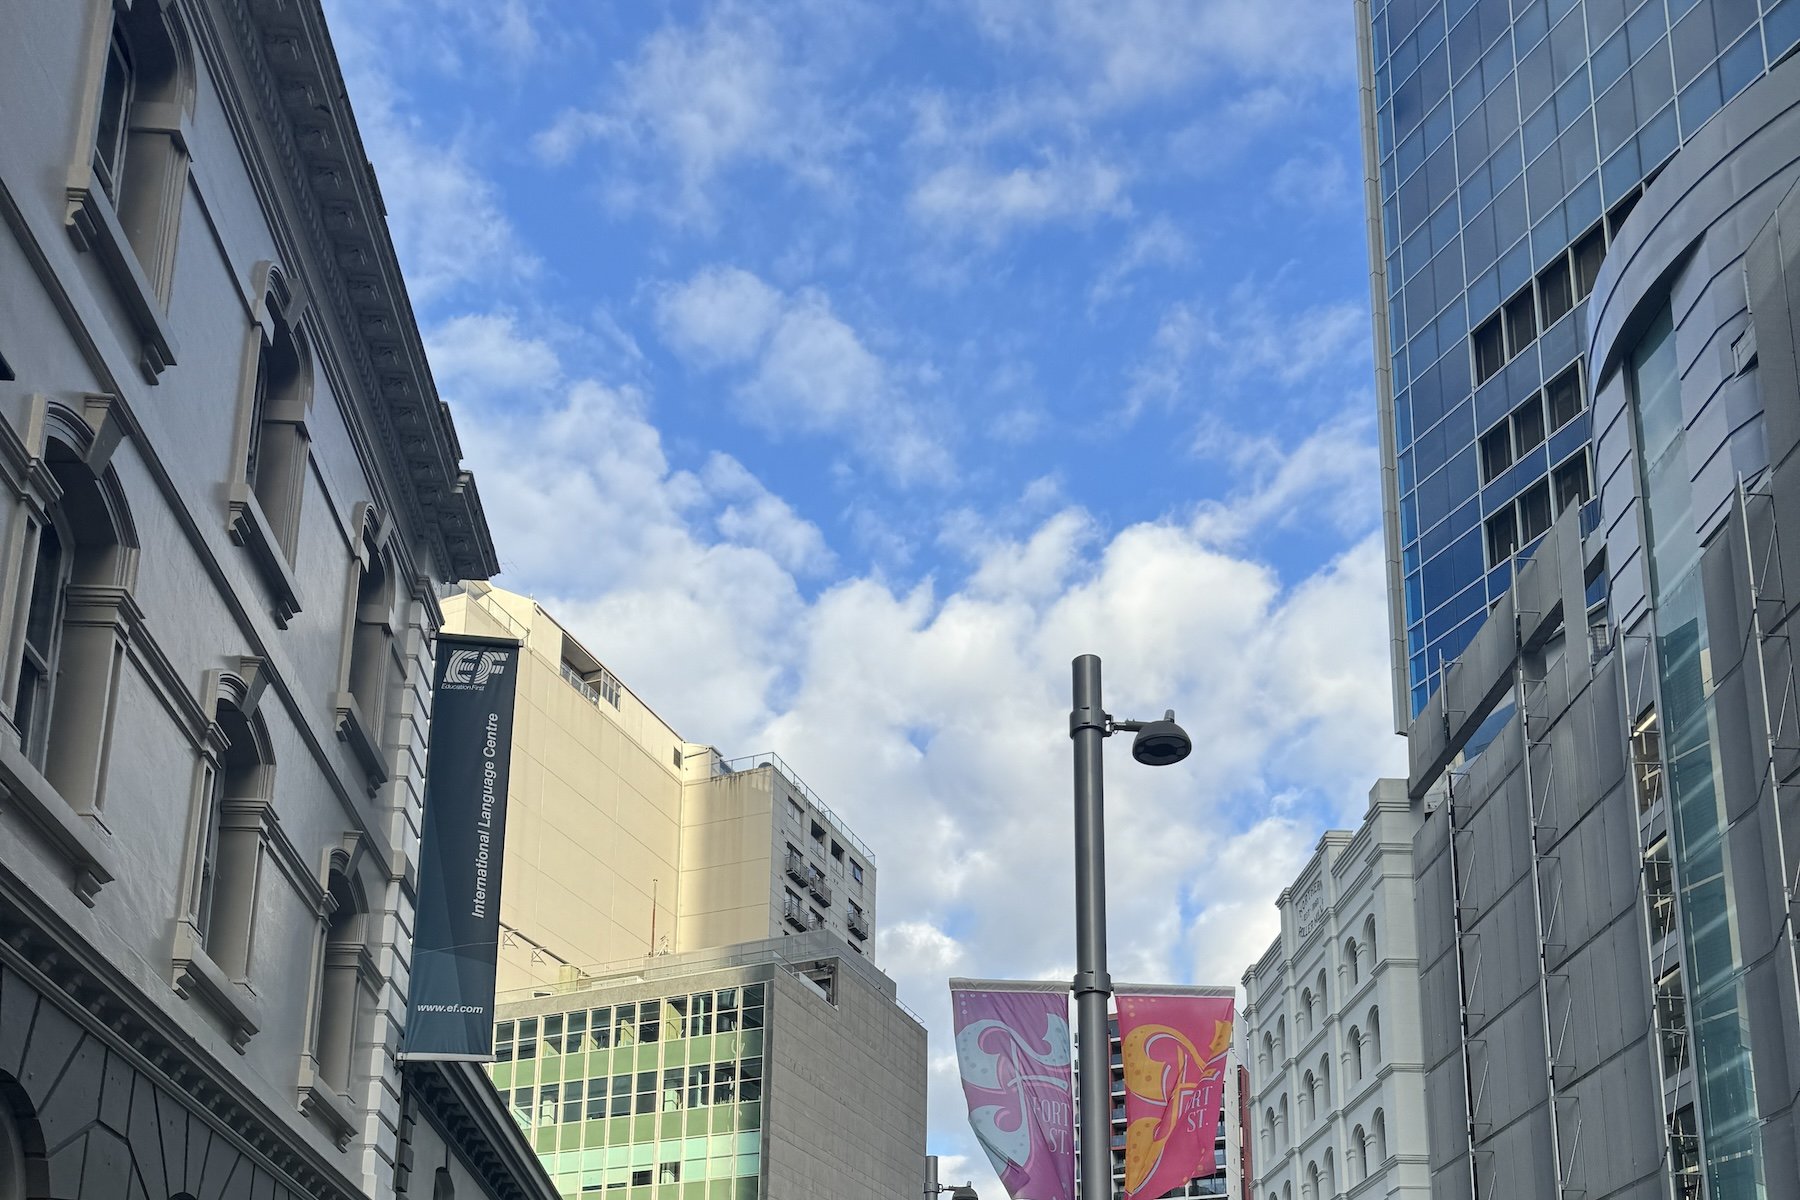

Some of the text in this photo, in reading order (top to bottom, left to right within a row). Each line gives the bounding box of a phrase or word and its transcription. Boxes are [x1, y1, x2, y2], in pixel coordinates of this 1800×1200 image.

[443, 649, 509, 685] EF
[472, 711, 499, 919] International Language Centre
[417, 1001, 484, 1016] www.ef.com
[1187, 1108, 1209, 1133] ST.
[1048, 1127, 1069, 1155] ST.
